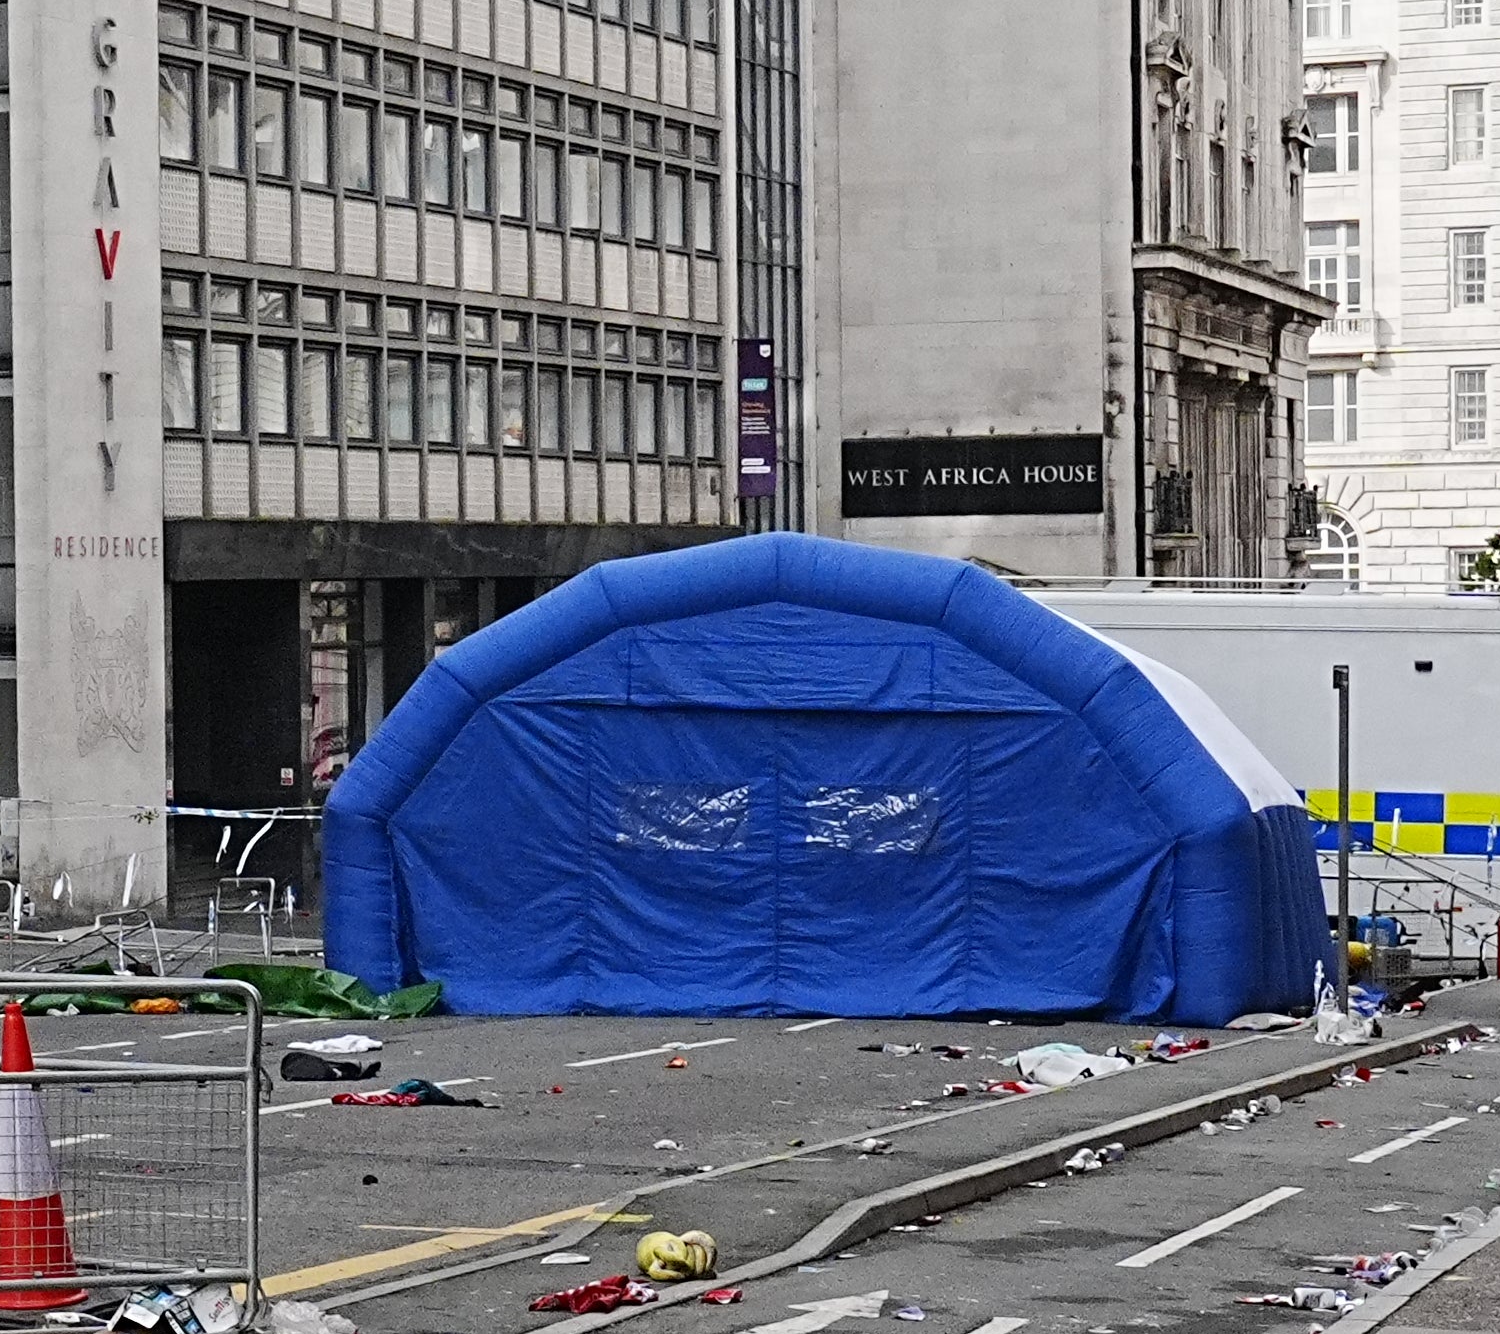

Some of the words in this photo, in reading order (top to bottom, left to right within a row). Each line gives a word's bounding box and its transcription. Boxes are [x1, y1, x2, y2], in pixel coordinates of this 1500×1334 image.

[92, 18, 122, 493] GRAVITY
[848, 468, 910, 487] WEST
[922, 466, 1012, 486] AFRICA
[1023, 464, 1098, 484] HOUSE
[54, 535, 161, 560] RESIDENCE
